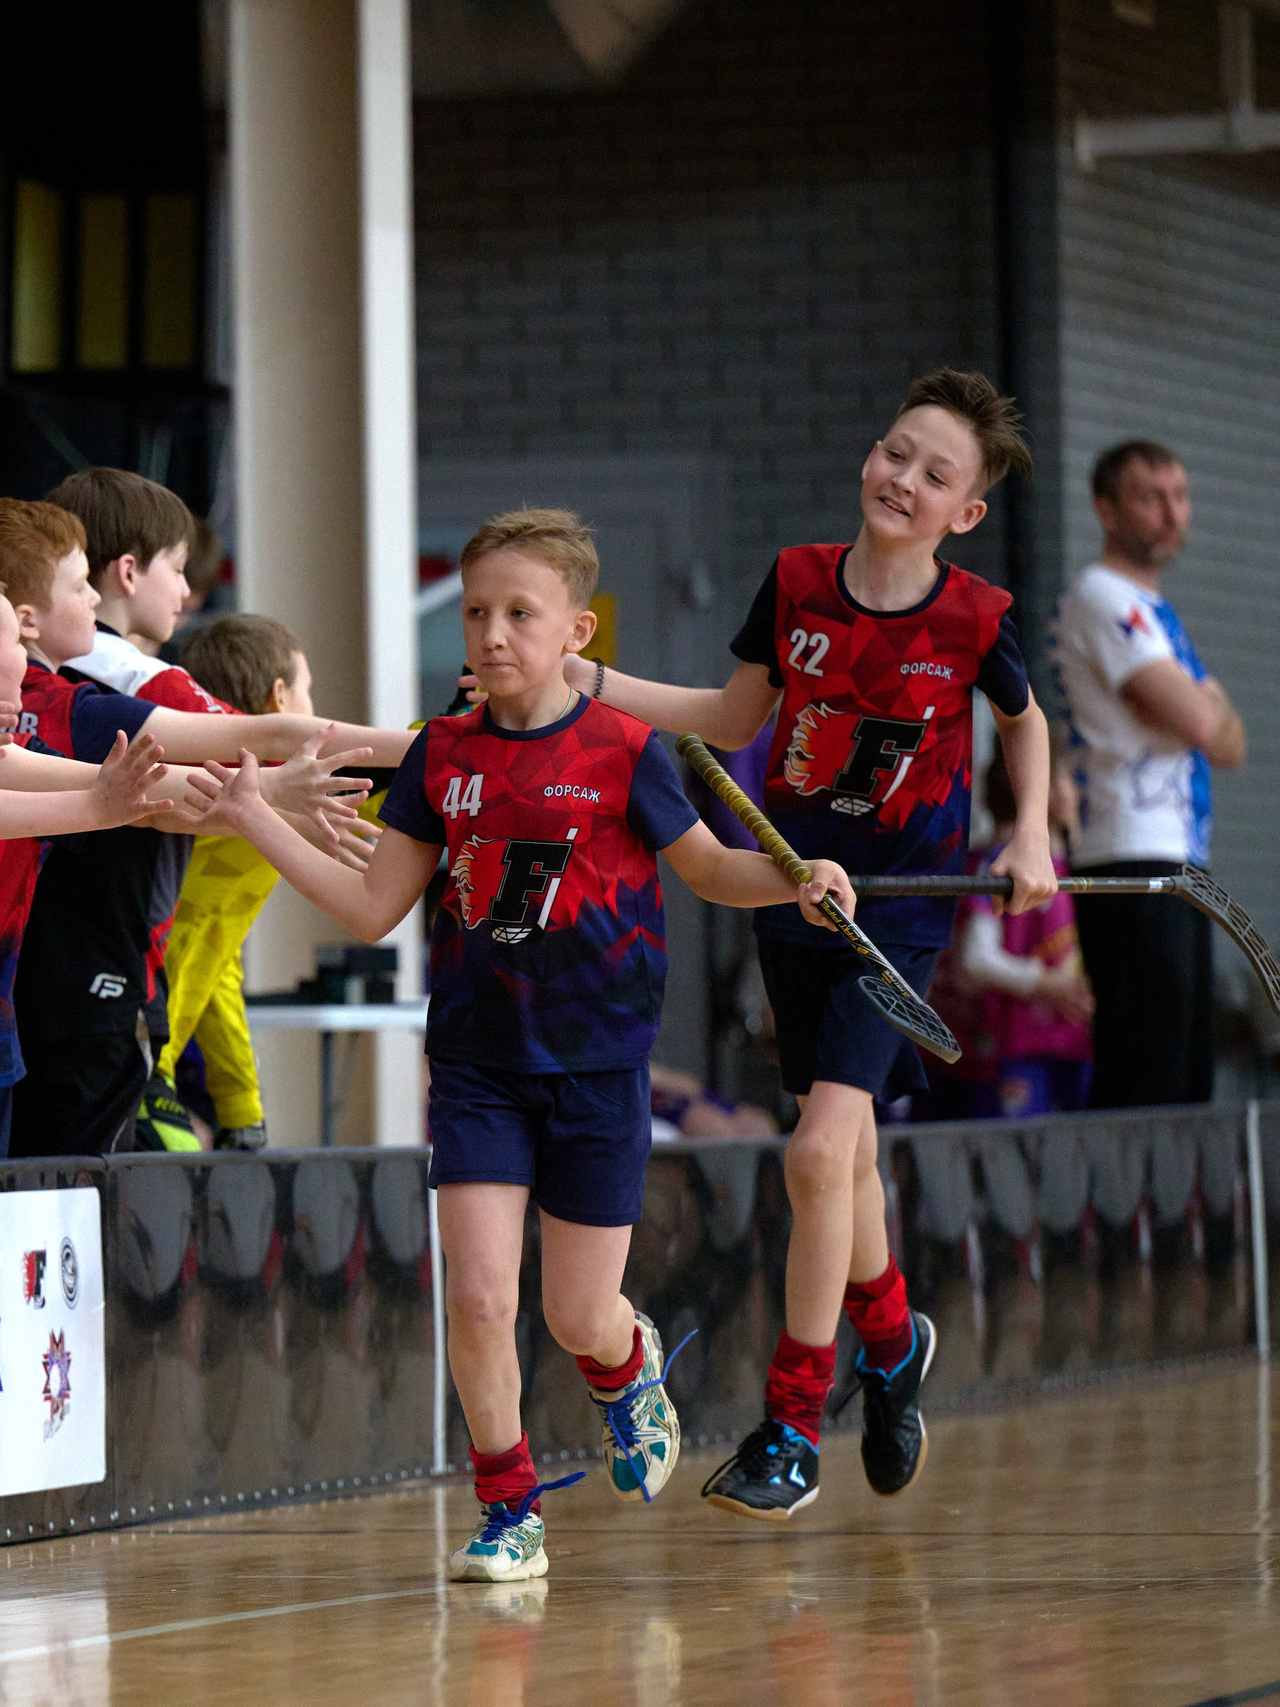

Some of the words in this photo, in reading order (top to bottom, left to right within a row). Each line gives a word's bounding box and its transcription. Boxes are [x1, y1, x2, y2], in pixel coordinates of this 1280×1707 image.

[787, 628, 830, 678] 22
[899, 661, 954, 681] ФОРСАЖ
[442, 773, 484, 820] 44
[543, 784, 602, 804] ФОРСАЖ
